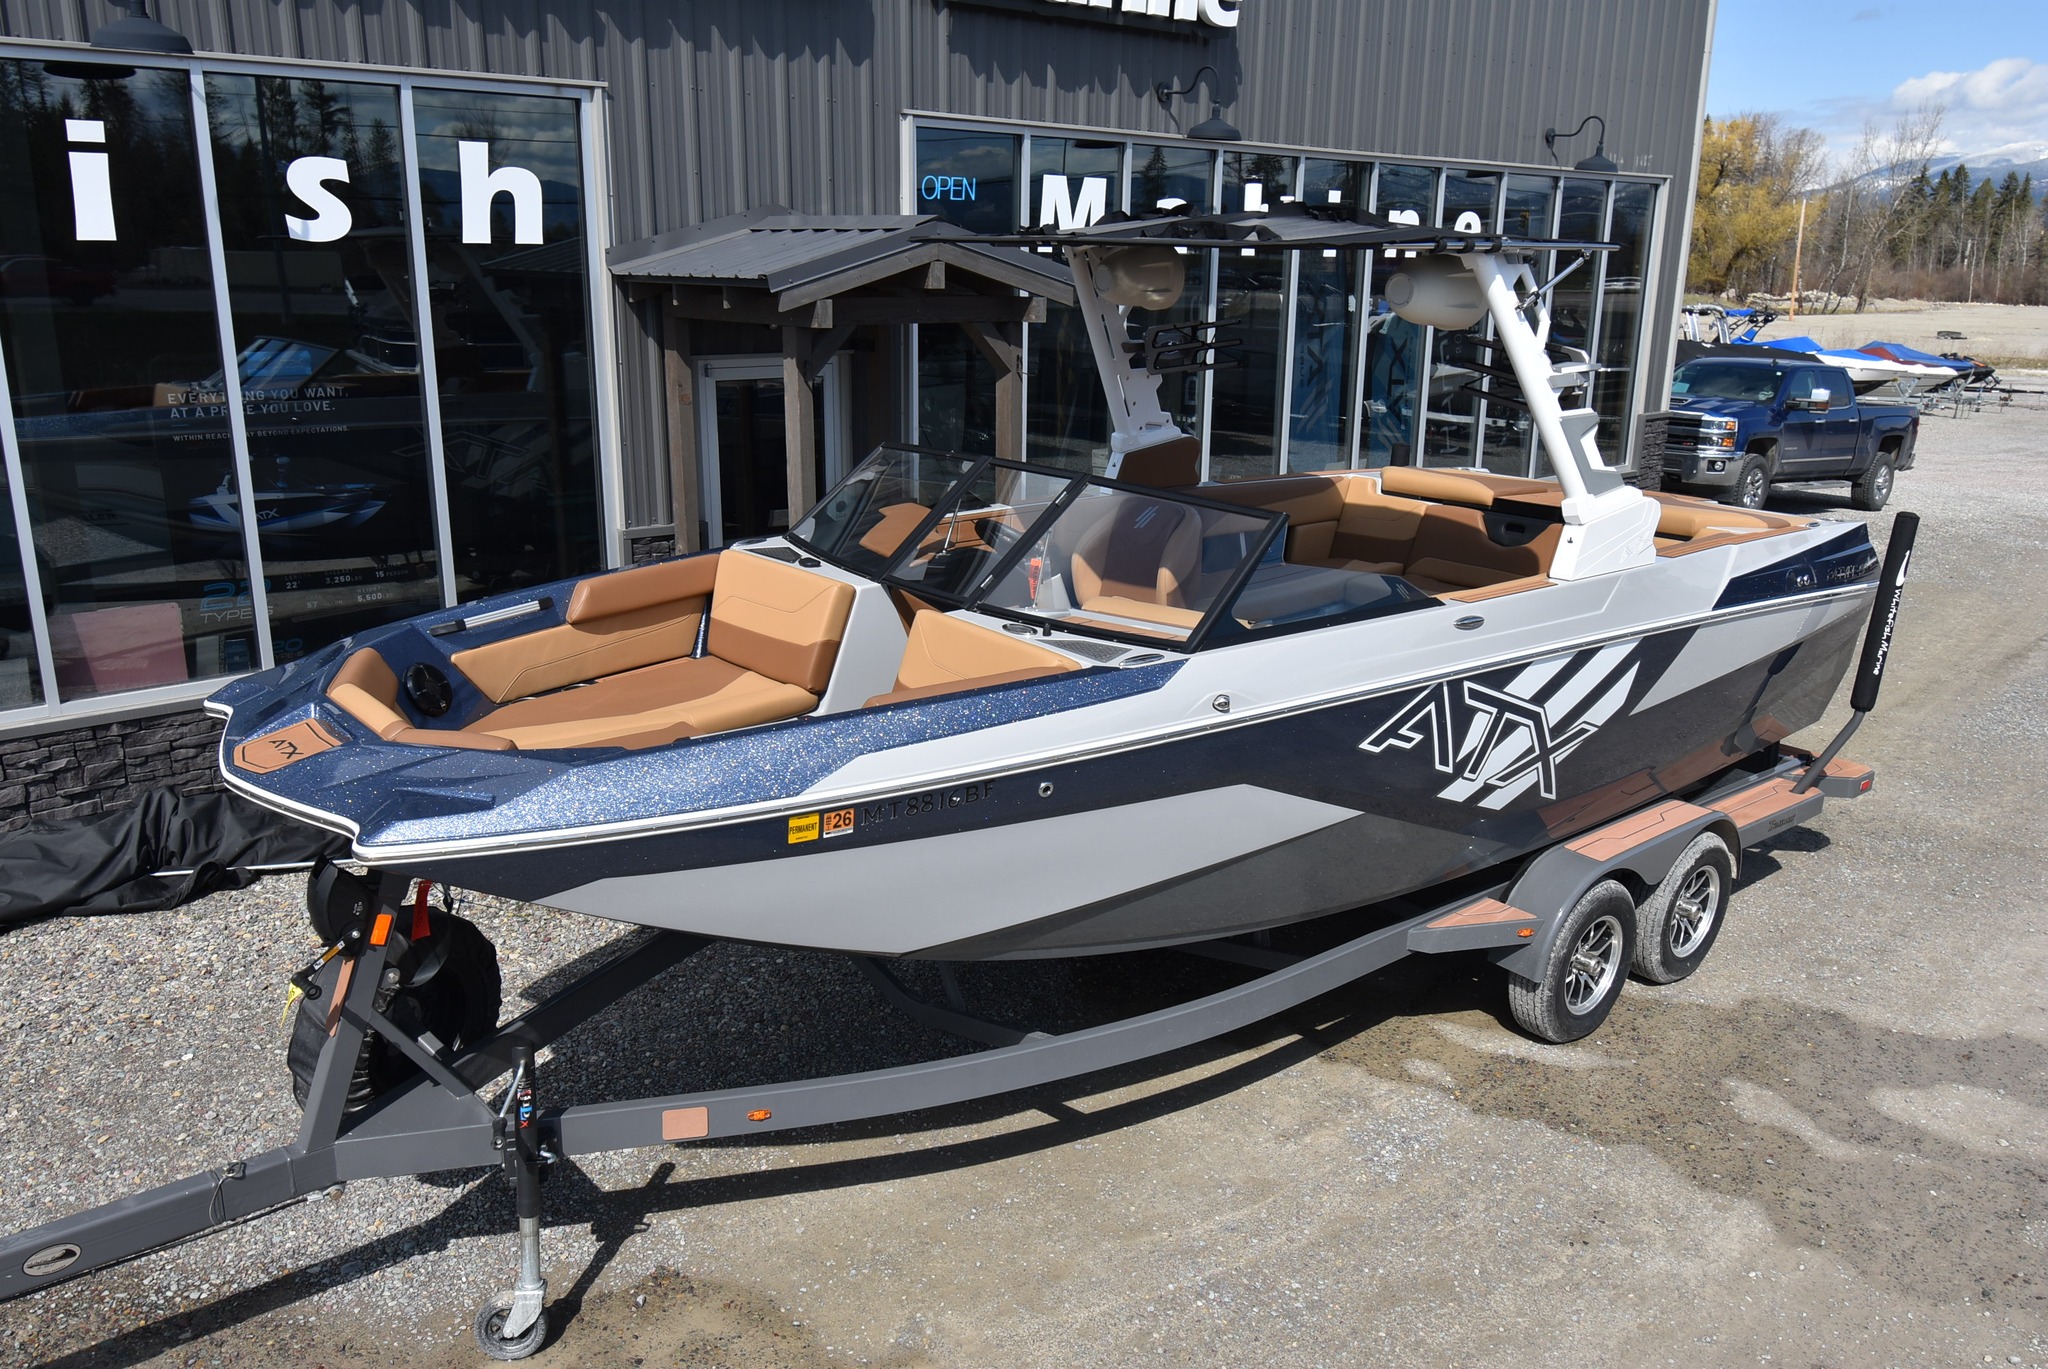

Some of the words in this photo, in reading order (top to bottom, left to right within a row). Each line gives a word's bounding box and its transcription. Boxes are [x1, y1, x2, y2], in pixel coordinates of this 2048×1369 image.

[921, 175, 976, 201] OPEN
[167, 390, 265, 404] EVERYTNG
[269, 388, 299, 400] YOU
[170, 407, 188, 418] AT
[195, 407, 205, 418] A
[210, 404, 255, 417] PRE
[260, 402, 288, 414] YOU
[294, 400, 336, 412] LOVE.
[173, 434, 203, 442] WITHIN
[257, 428, 288, 437] BEYOND
[1873, 641, 1889, 676] Marine
[1358, 680, 1599, 800] ATX
[268, 739, 304, 760] ATX
[789, 822, 818, 835] PERMANENT
[825, 814, 833, 826] FEB
[833, 811, 852, 829] 26
